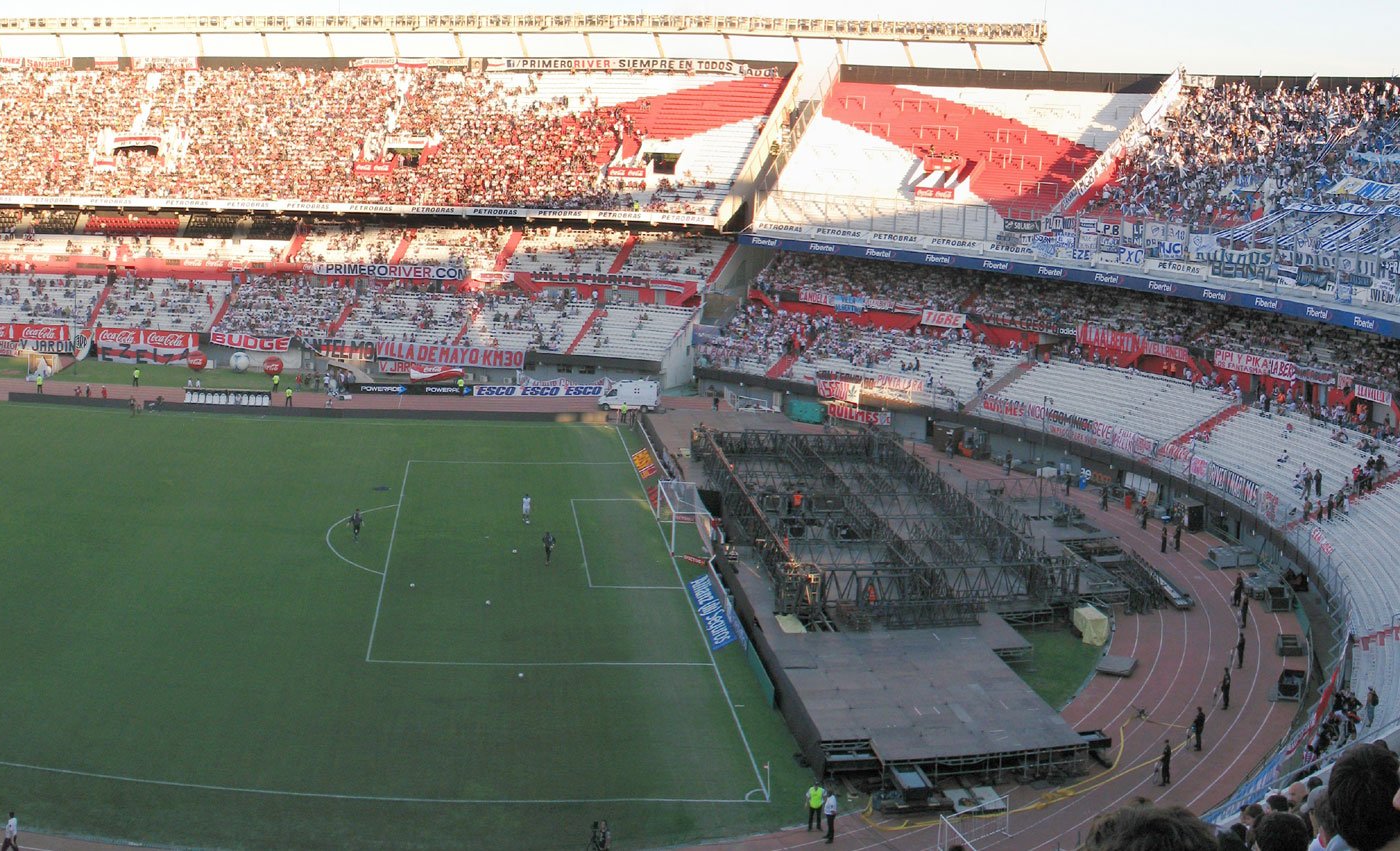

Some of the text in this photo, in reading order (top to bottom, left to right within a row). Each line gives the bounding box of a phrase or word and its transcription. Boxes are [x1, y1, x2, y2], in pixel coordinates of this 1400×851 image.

[619, 59, 733, 71] SIEMPRE EN TODOS
[598, 211, 642, 219] PETROBRAS
[661, 214, 705, 222] PETROBRAS
[759, 223, 976, 248] PETROBRAS PETROBRAS PETROBRAS PETROBRAS
[752, 237, 1375, 329] Fibertel Fibertel Fibertel Fibertel Fibertel Fibertel Fibertel Fibertel Fibertel Fibertel Fibertel Fibertel
[925, 311, 961, 326] TIGRE
[22, 327, 57, 339] Coca-Cola
[100, 329, 183, 347] Coca-Cola Coca-Cola
[211, 332, 292, 351] BUDGE
[376, 341, 417, 361] VILLA
[417, 346, 438, 363] DE
[438, 347, 479, 364] MAYO
[360, 384, 402, 393] POWERADE
[477, 385, 602, 396] ESCO ESCO ESCO
[828, 404, 879, 424] QUILMES
[705, 608, 732, 645] Seguros
